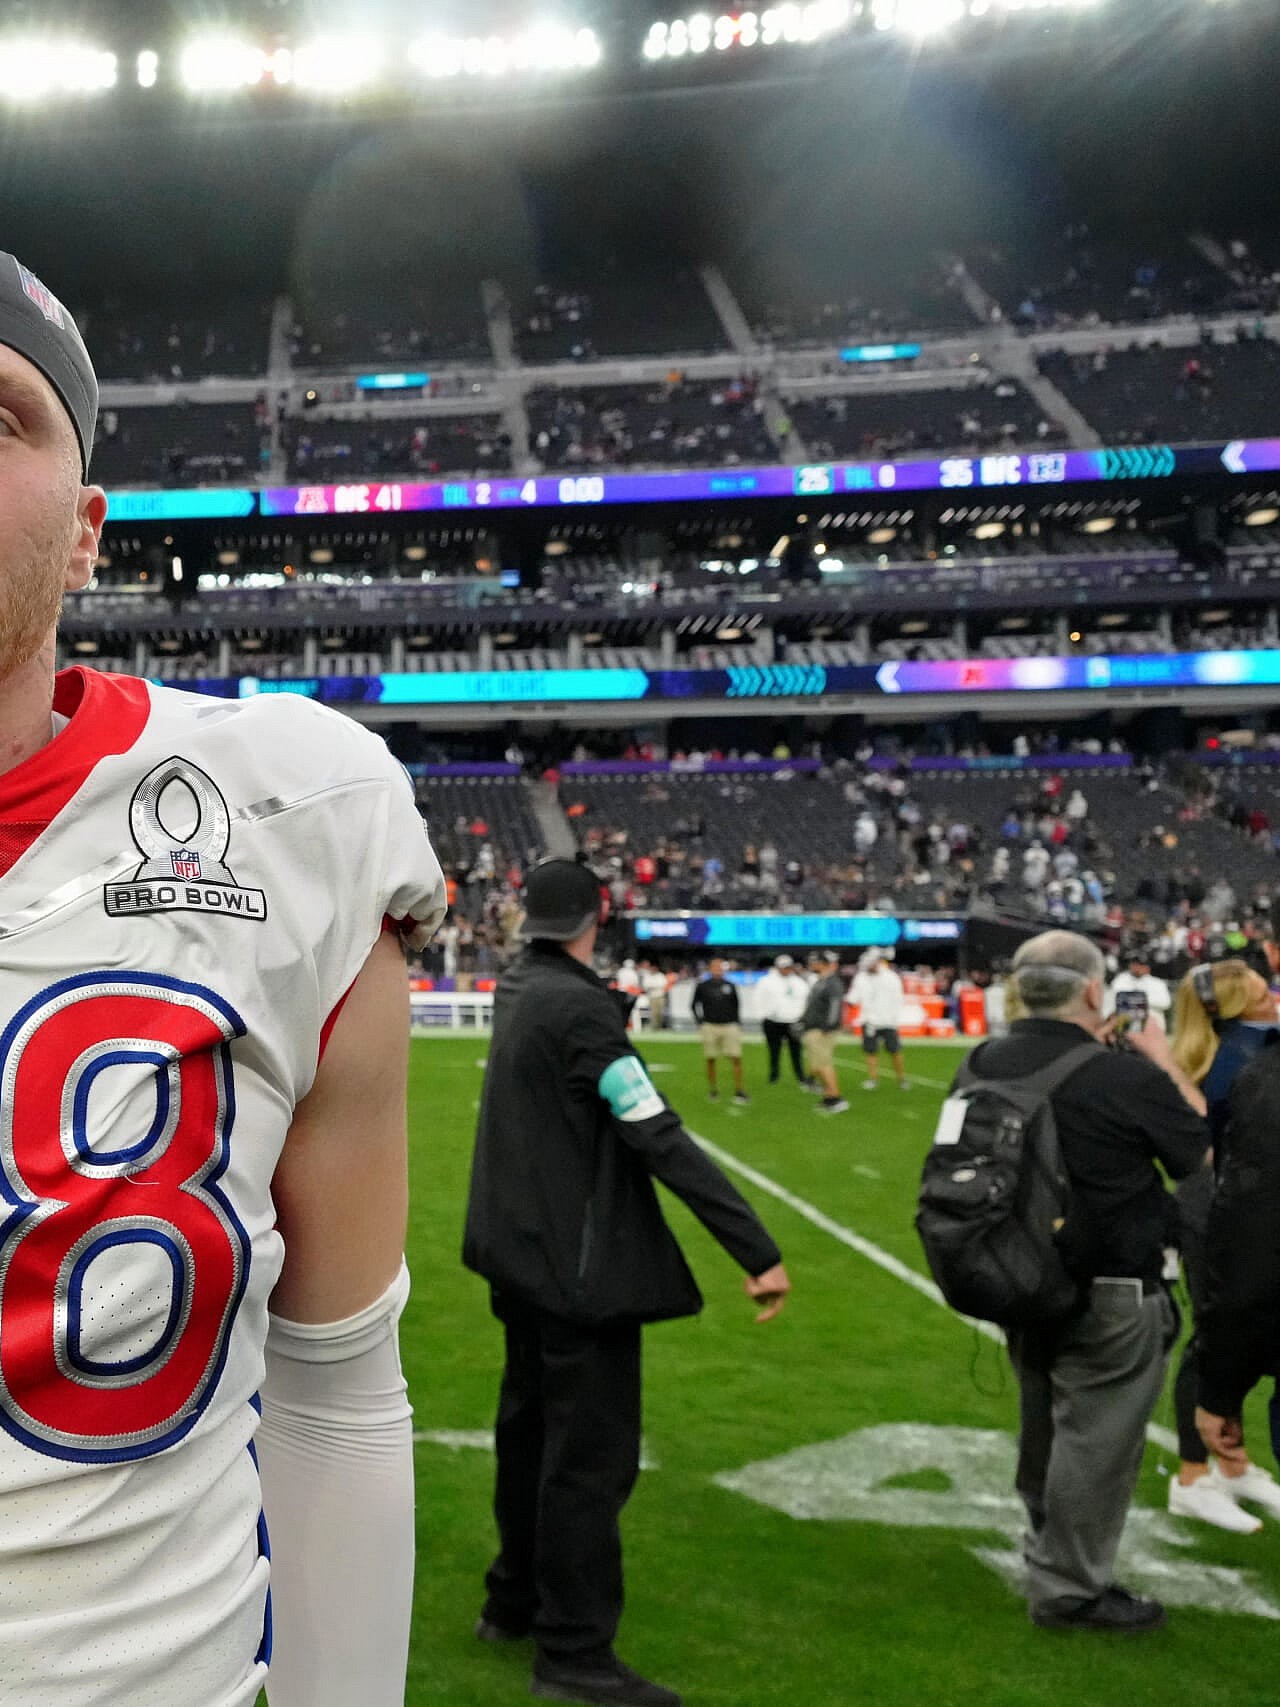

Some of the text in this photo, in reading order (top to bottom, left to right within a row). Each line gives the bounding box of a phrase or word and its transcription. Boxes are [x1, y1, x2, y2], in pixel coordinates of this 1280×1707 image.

[375, 484, 402, 511] 41
[476, 482, 491, 504] 2
[520, 479, 537, 504] 4
[174, 861, 200, 878] NFL
[109, 886, 260, 913] PRO BOWL
